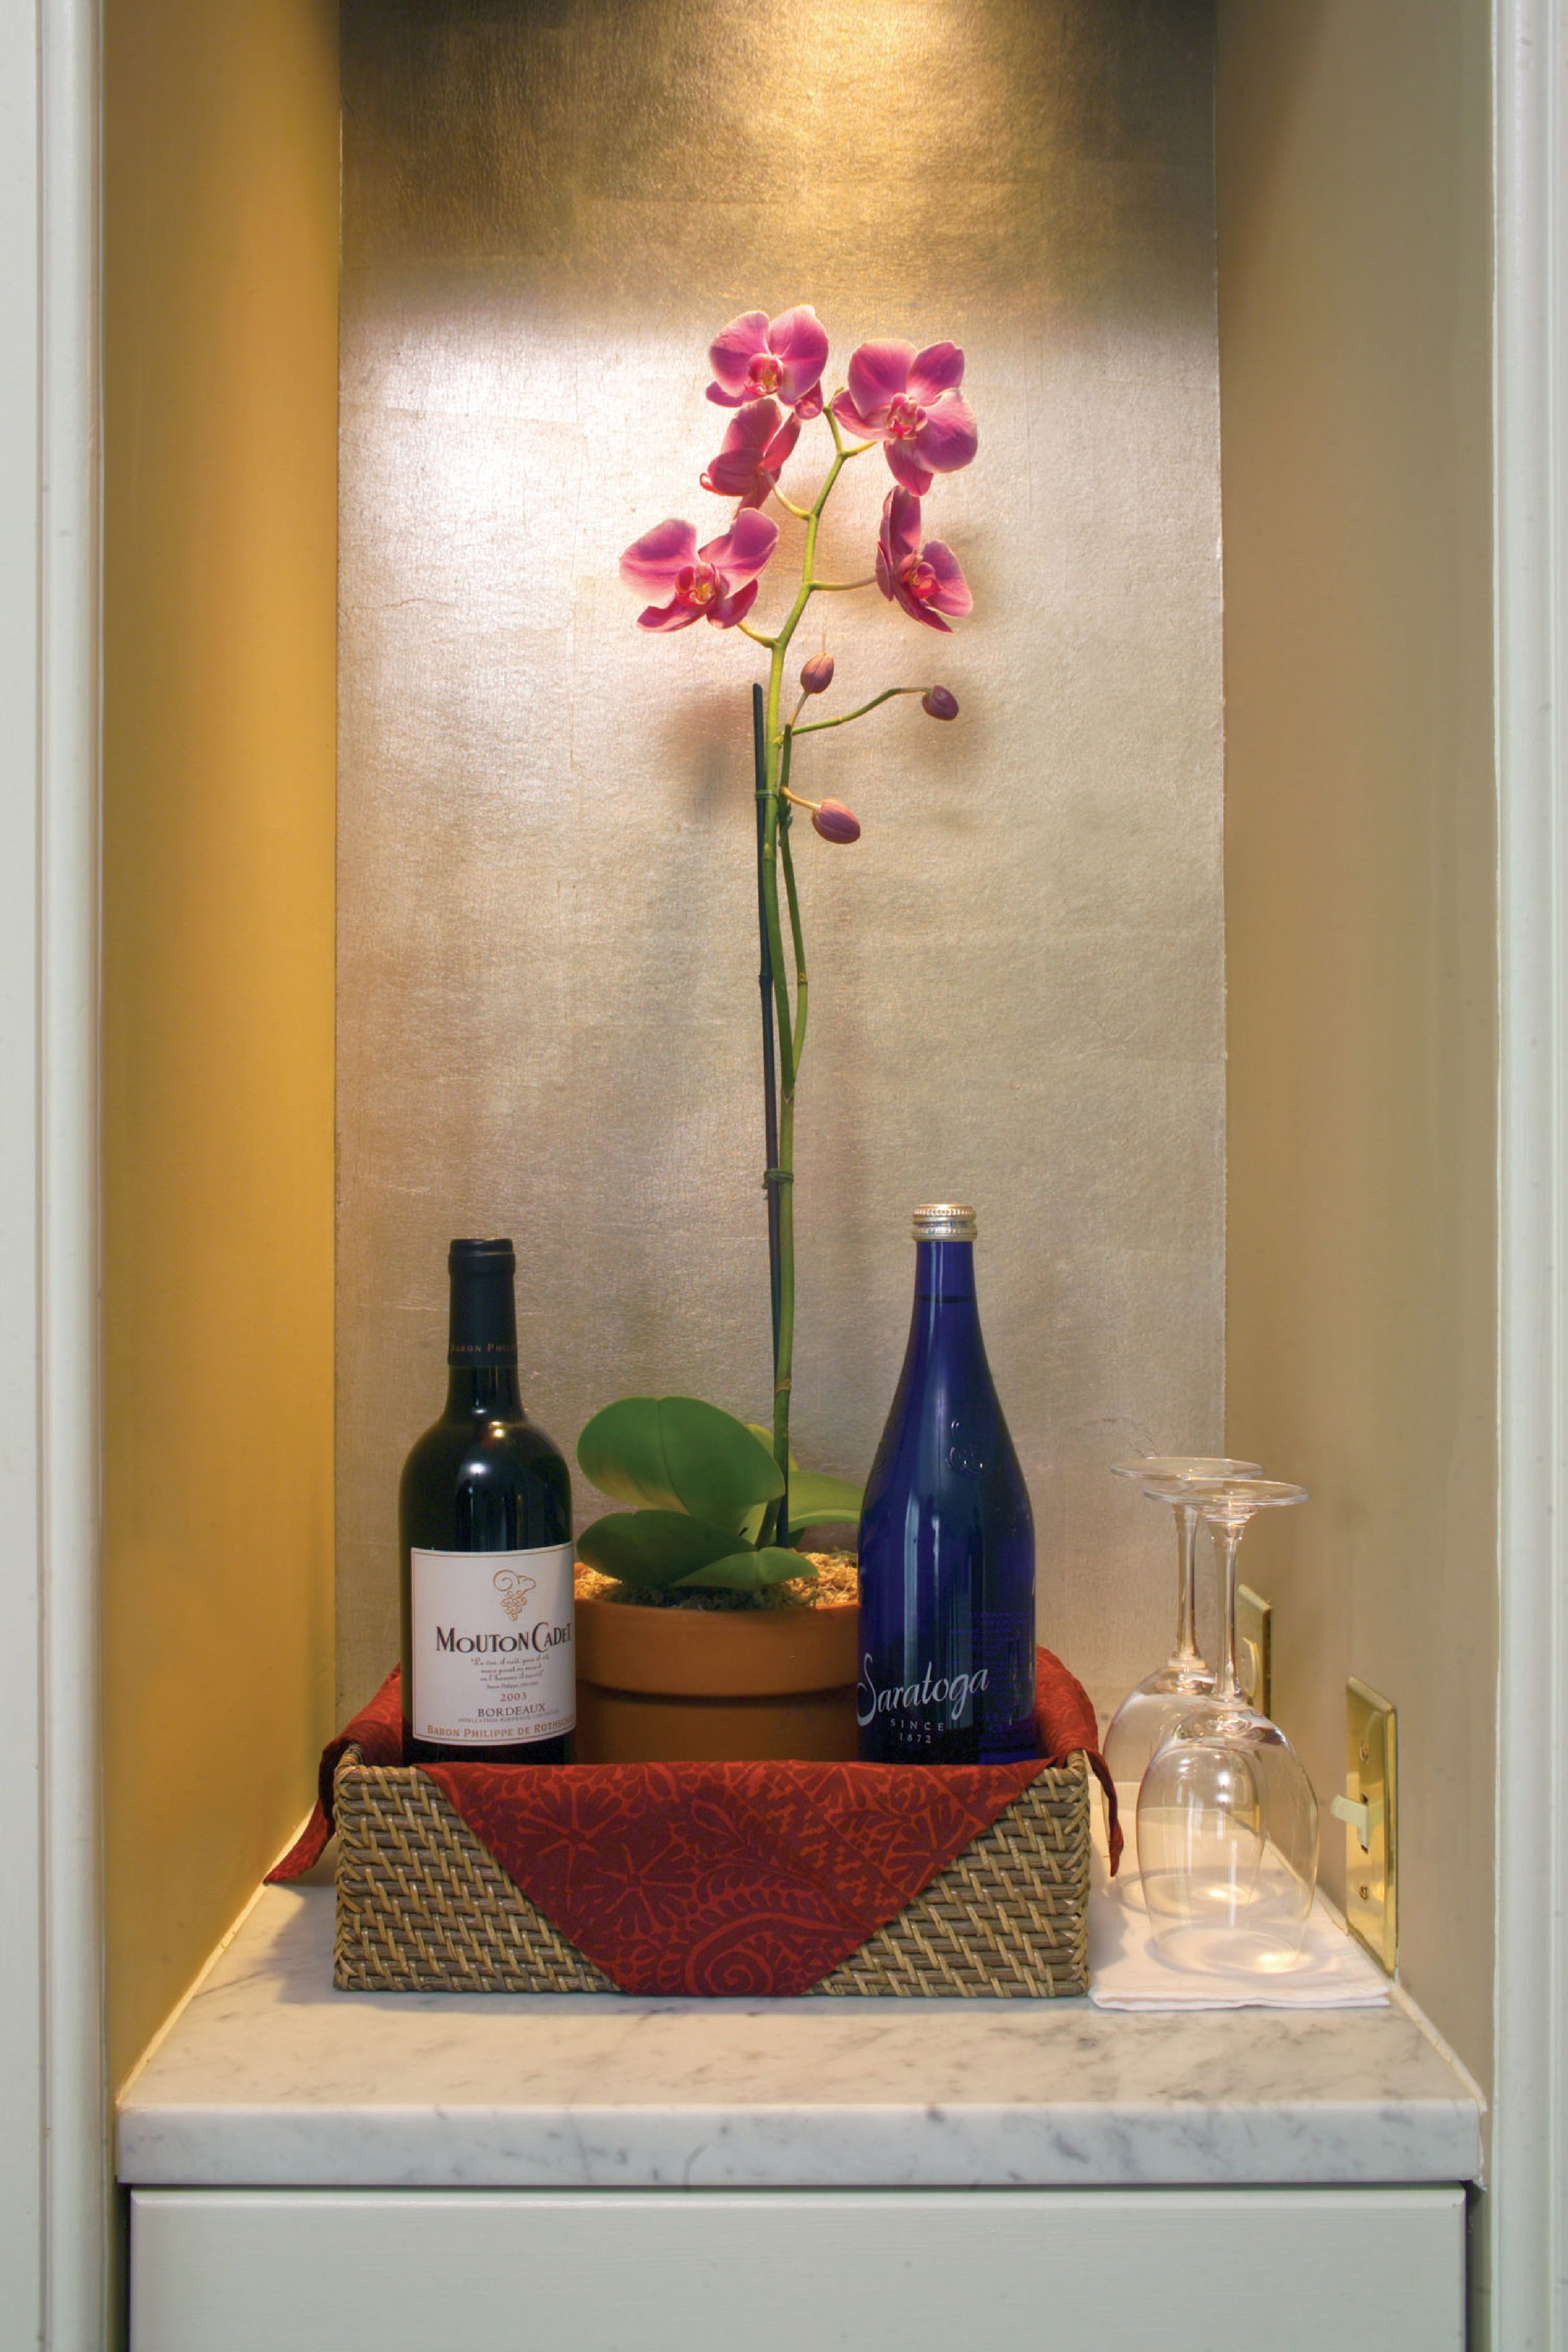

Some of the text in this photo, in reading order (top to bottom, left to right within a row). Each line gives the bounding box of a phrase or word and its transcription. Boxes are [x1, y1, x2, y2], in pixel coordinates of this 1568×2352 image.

[435, 1622, 571, 1653] MOUTON CADET
[858, 1653, 989, 1726] Saratoga
[500, 1692, 527, 1702] 2003
[478, 1703, 546, 1717] BORDEAUX
[427, 1724, 460, 1736] BARON
[464, 1727, 512, 1738] PHILIPPE
[518, 1725, 531, 1735] DE
[890, 1718, 944, 1732] SINCE
[899, 1732, 932, 1744] 1872
